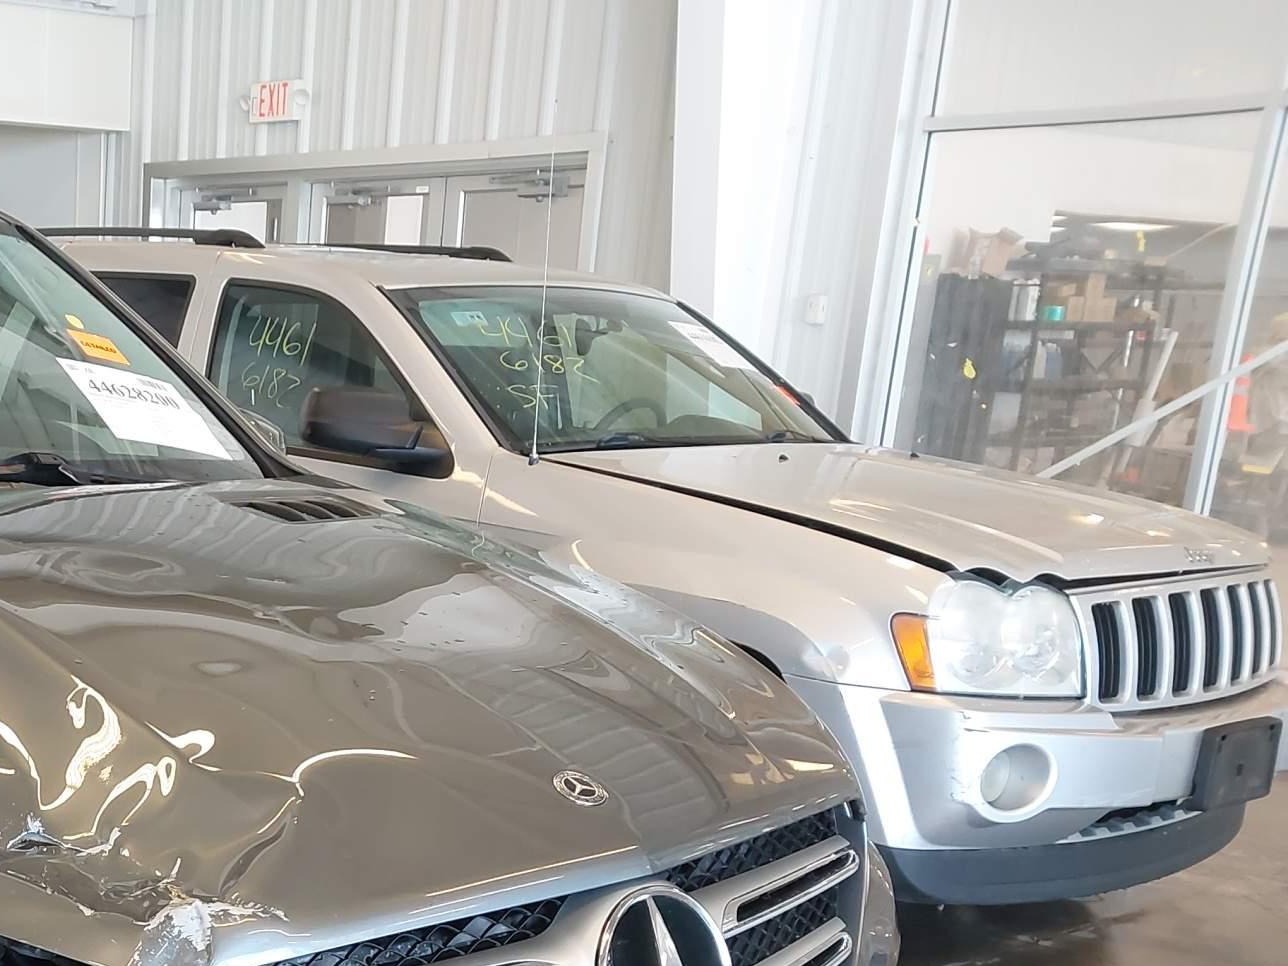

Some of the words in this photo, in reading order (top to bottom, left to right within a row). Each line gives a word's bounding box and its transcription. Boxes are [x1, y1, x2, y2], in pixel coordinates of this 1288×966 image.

[259, 83, 289, 117] EXIT
[249, 315, 318, 367] 4461
[88, 379, 181, 410] 44628200
